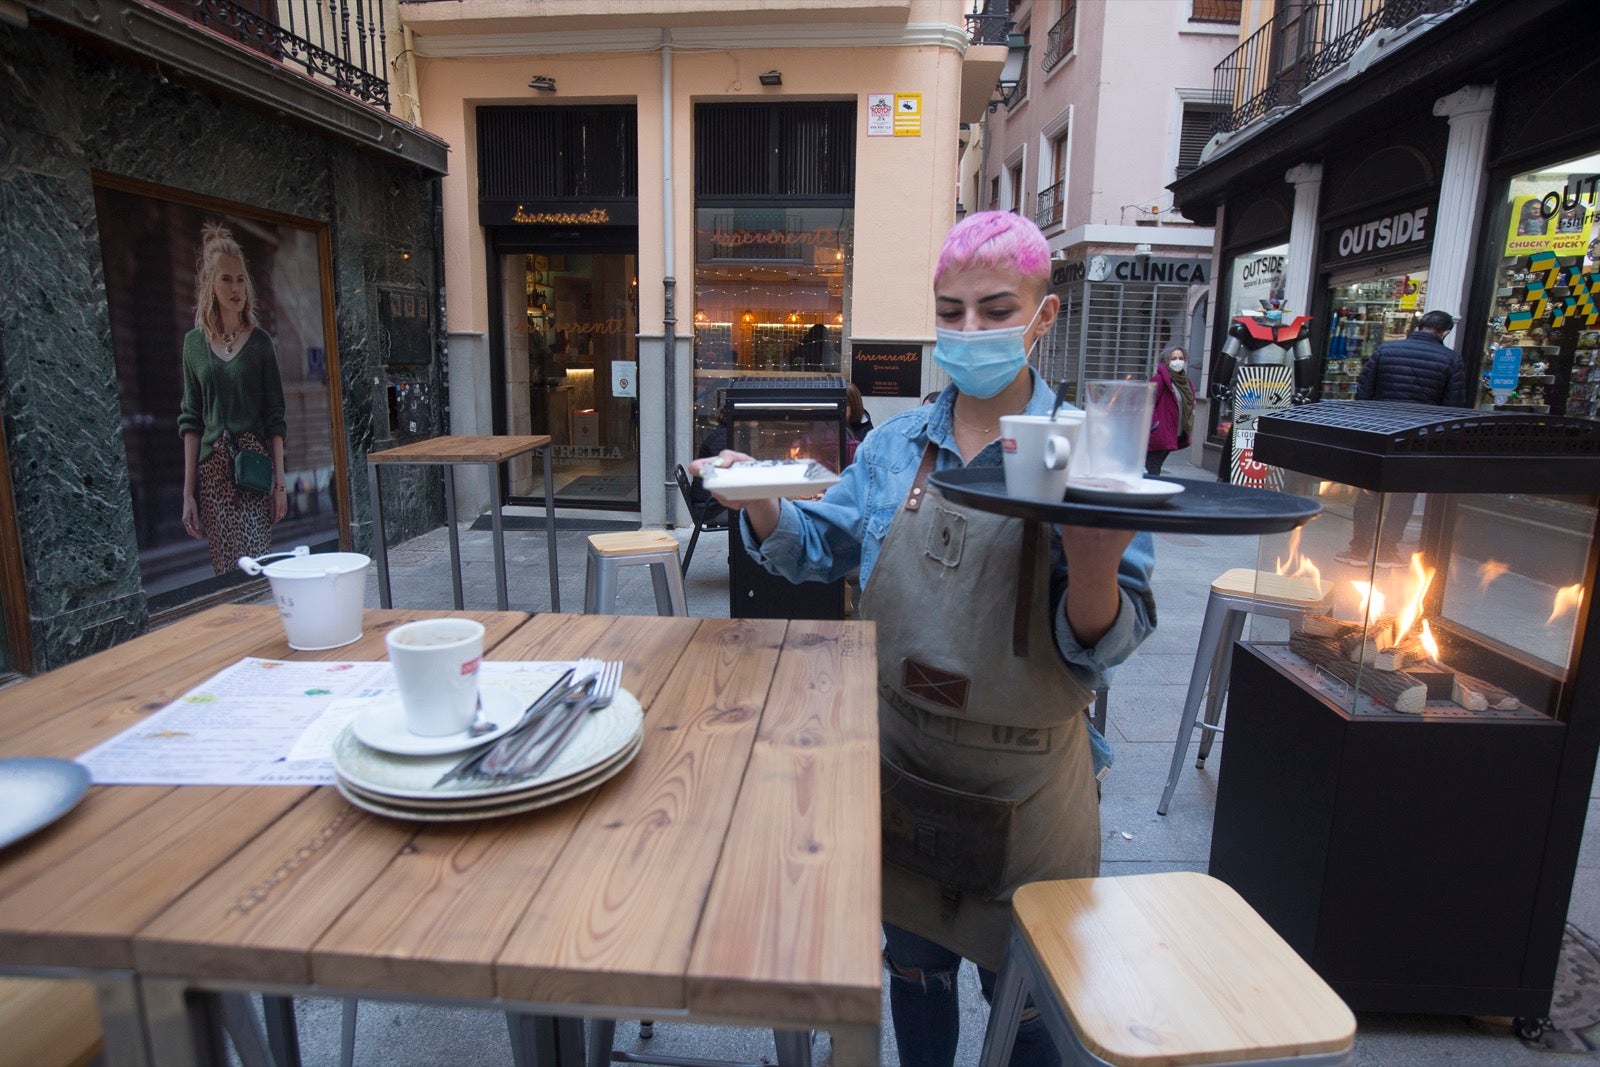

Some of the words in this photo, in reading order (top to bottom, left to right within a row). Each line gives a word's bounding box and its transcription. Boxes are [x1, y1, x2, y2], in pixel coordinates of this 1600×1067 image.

[1339, 207, 1428, 257] OUTSIDE
[1509, 241, 1550, 249] CHUCKY
[1115, 257, 1205, 283] CLÍNICA
[1243, 256, 1284, 280] OUTSIDE
[531, 444, 623, 460] STRELLA
